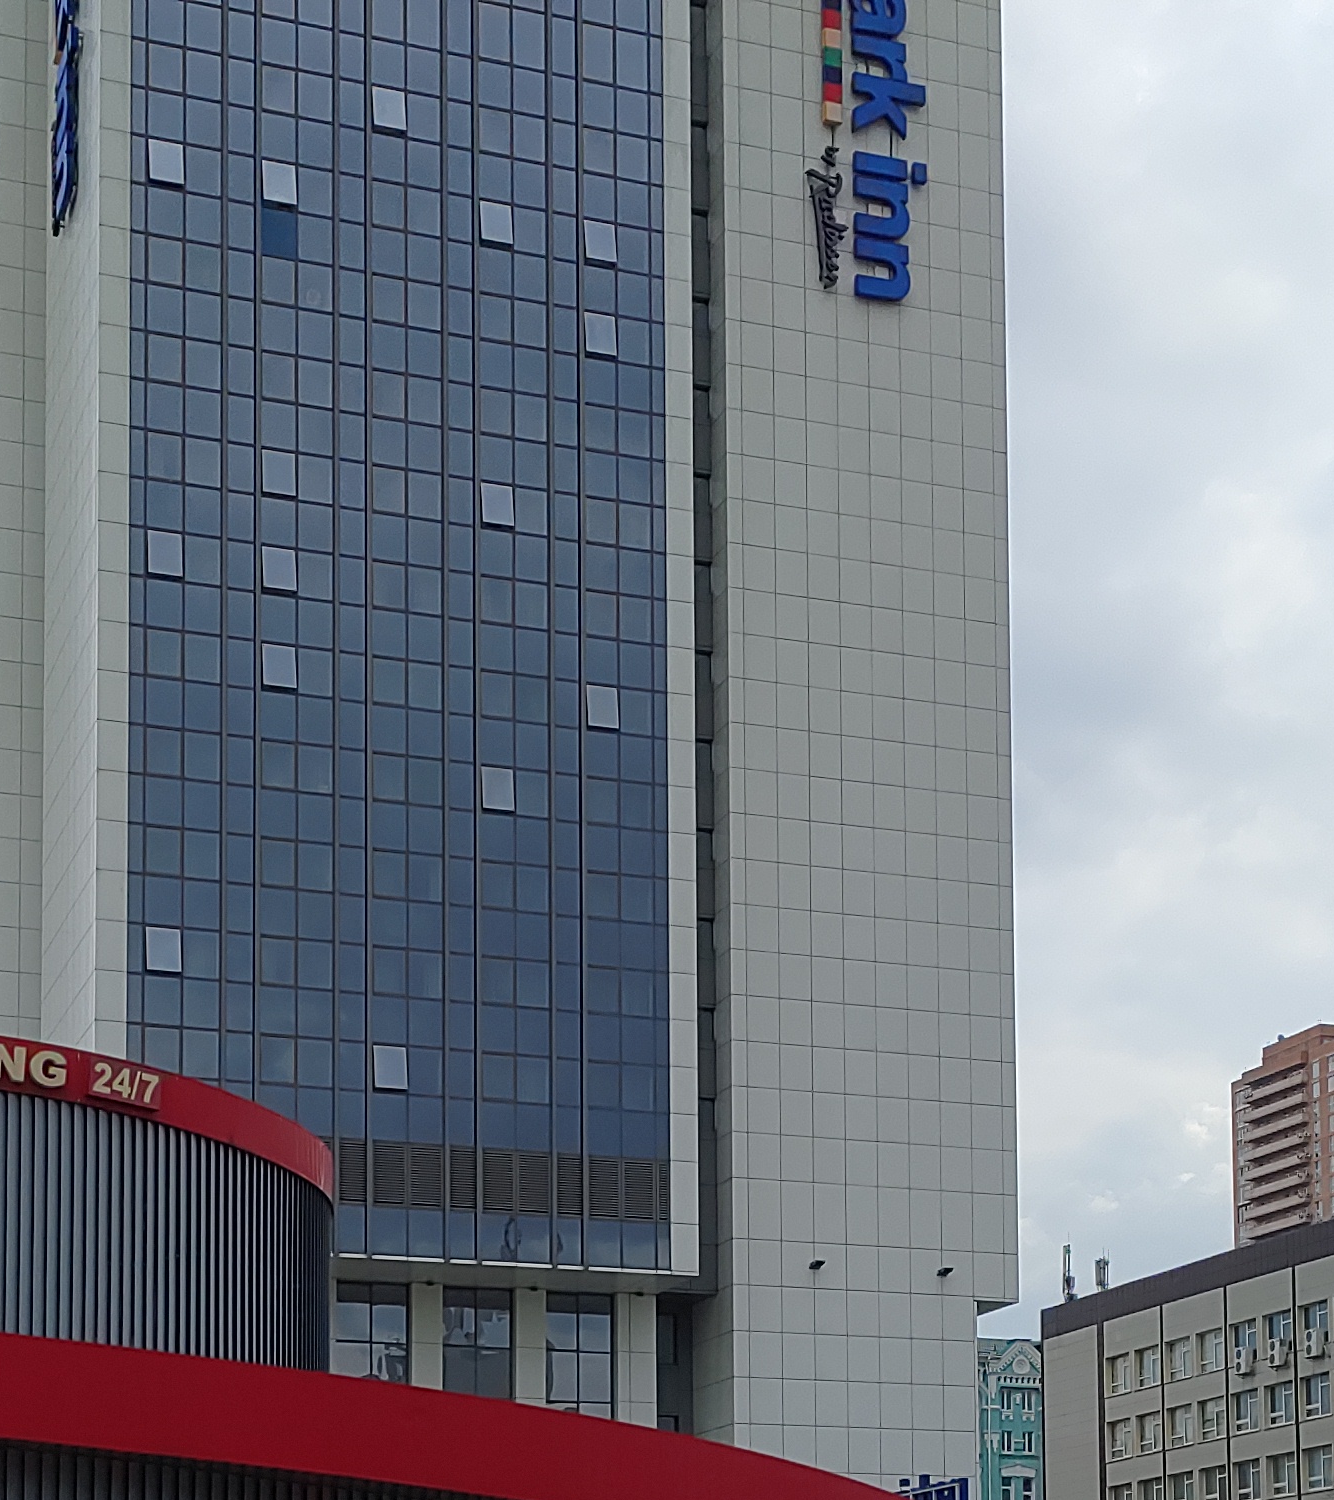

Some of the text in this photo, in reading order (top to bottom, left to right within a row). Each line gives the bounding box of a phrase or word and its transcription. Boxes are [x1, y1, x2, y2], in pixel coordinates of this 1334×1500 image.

[849, 0, 927, 301] ark inn
[804, 167, 849, 290] Radisson
[91, 1061, 160, 1105] 24/7
